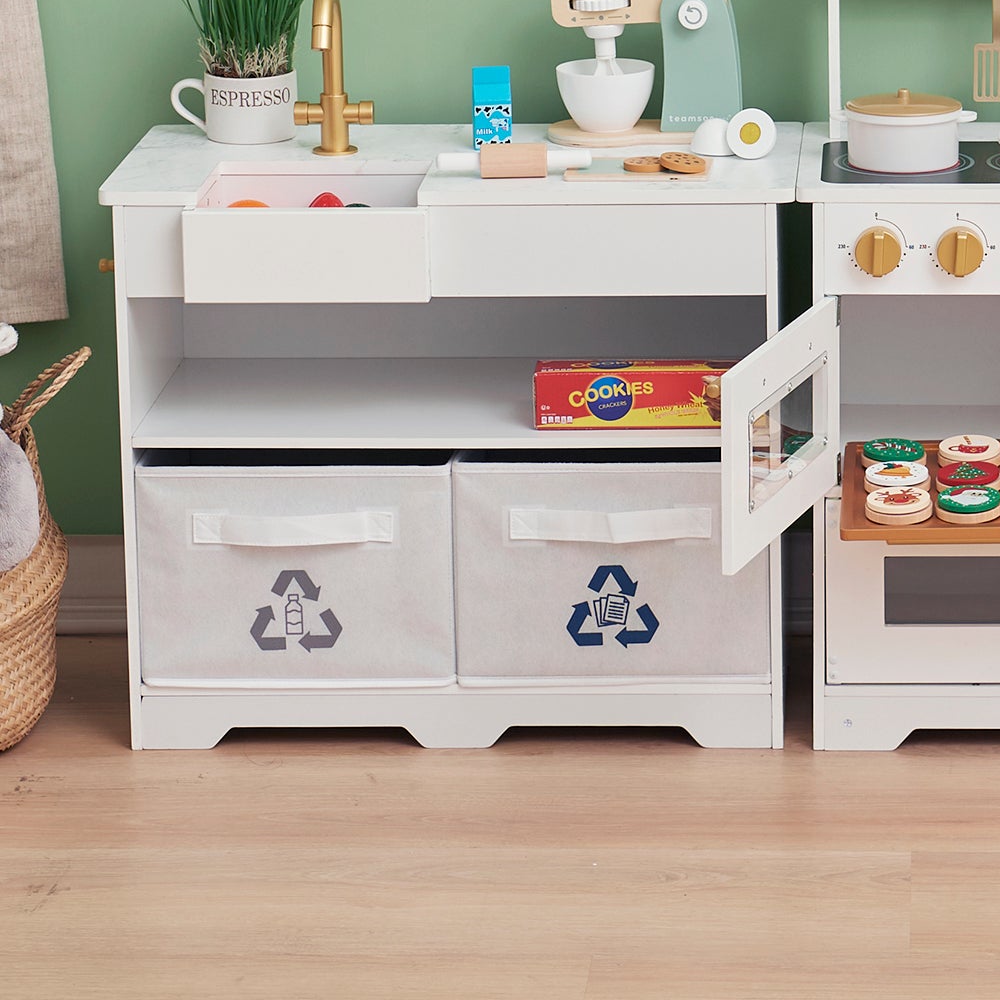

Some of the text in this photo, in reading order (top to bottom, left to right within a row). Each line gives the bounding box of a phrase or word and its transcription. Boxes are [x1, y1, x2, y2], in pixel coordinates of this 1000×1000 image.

[211, 87, 290, 107] ESPRESSO
[568, 381, 654, 408] COOKIES
[598, 400, 627, 410] CRACKERS
